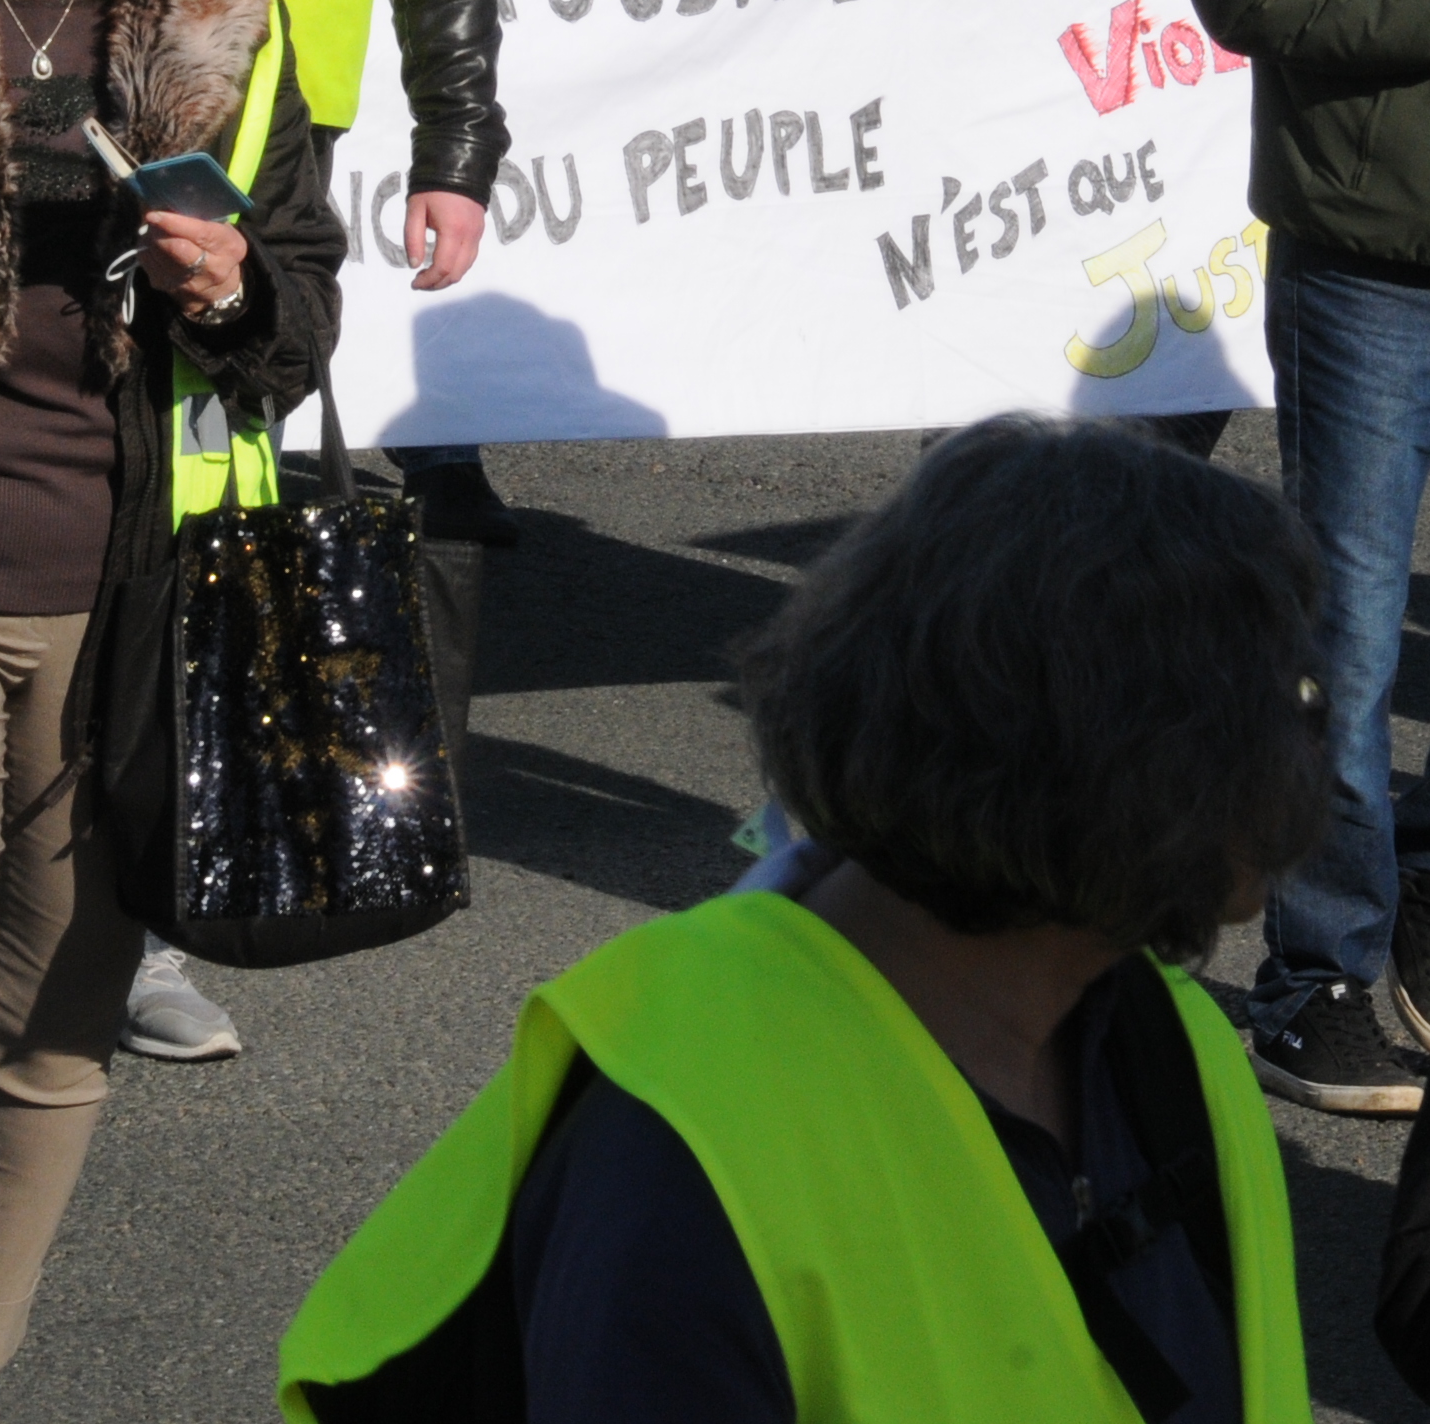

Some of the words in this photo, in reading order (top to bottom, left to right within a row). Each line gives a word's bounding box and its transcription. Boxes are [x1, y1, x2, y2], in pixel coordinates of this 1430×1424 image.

[490, 153, 583, 246] DU
[622, 96, 885, 225] PEUPLE
[876, 158, 1049, 311] N'EST
[1067, 138, 1165, 217] QUE
